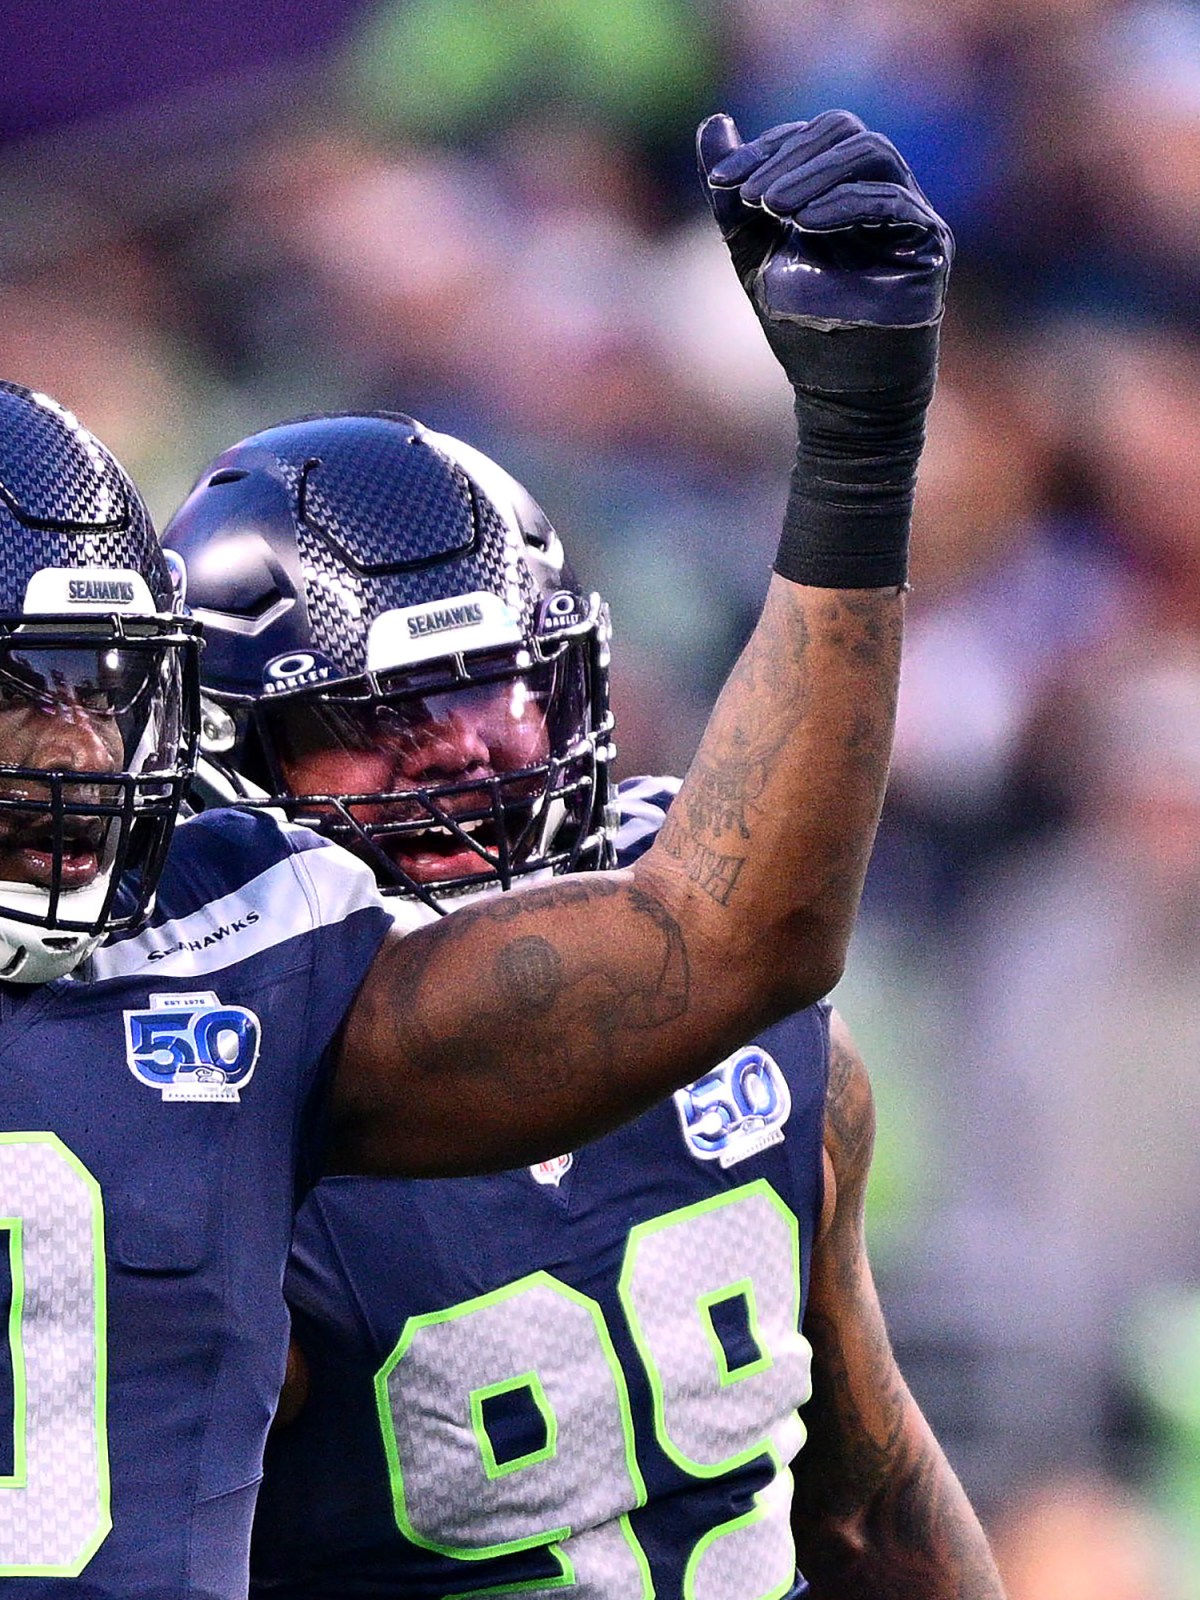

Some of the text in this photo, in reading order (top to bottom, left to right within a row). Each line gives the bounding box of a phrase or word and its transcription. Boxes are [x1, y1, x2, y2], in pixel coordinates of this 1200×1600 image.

[68, 580, 134, 602] SEAHAWKS
[407, 603, 483, 636] SEAHAWKS
[264, 666, 329, 693] OAKLEY
[129, 1010, 258, 1084] 50
[683, 1053, 780, 1153] 50
[373, 1178, 812, 1600] 99
